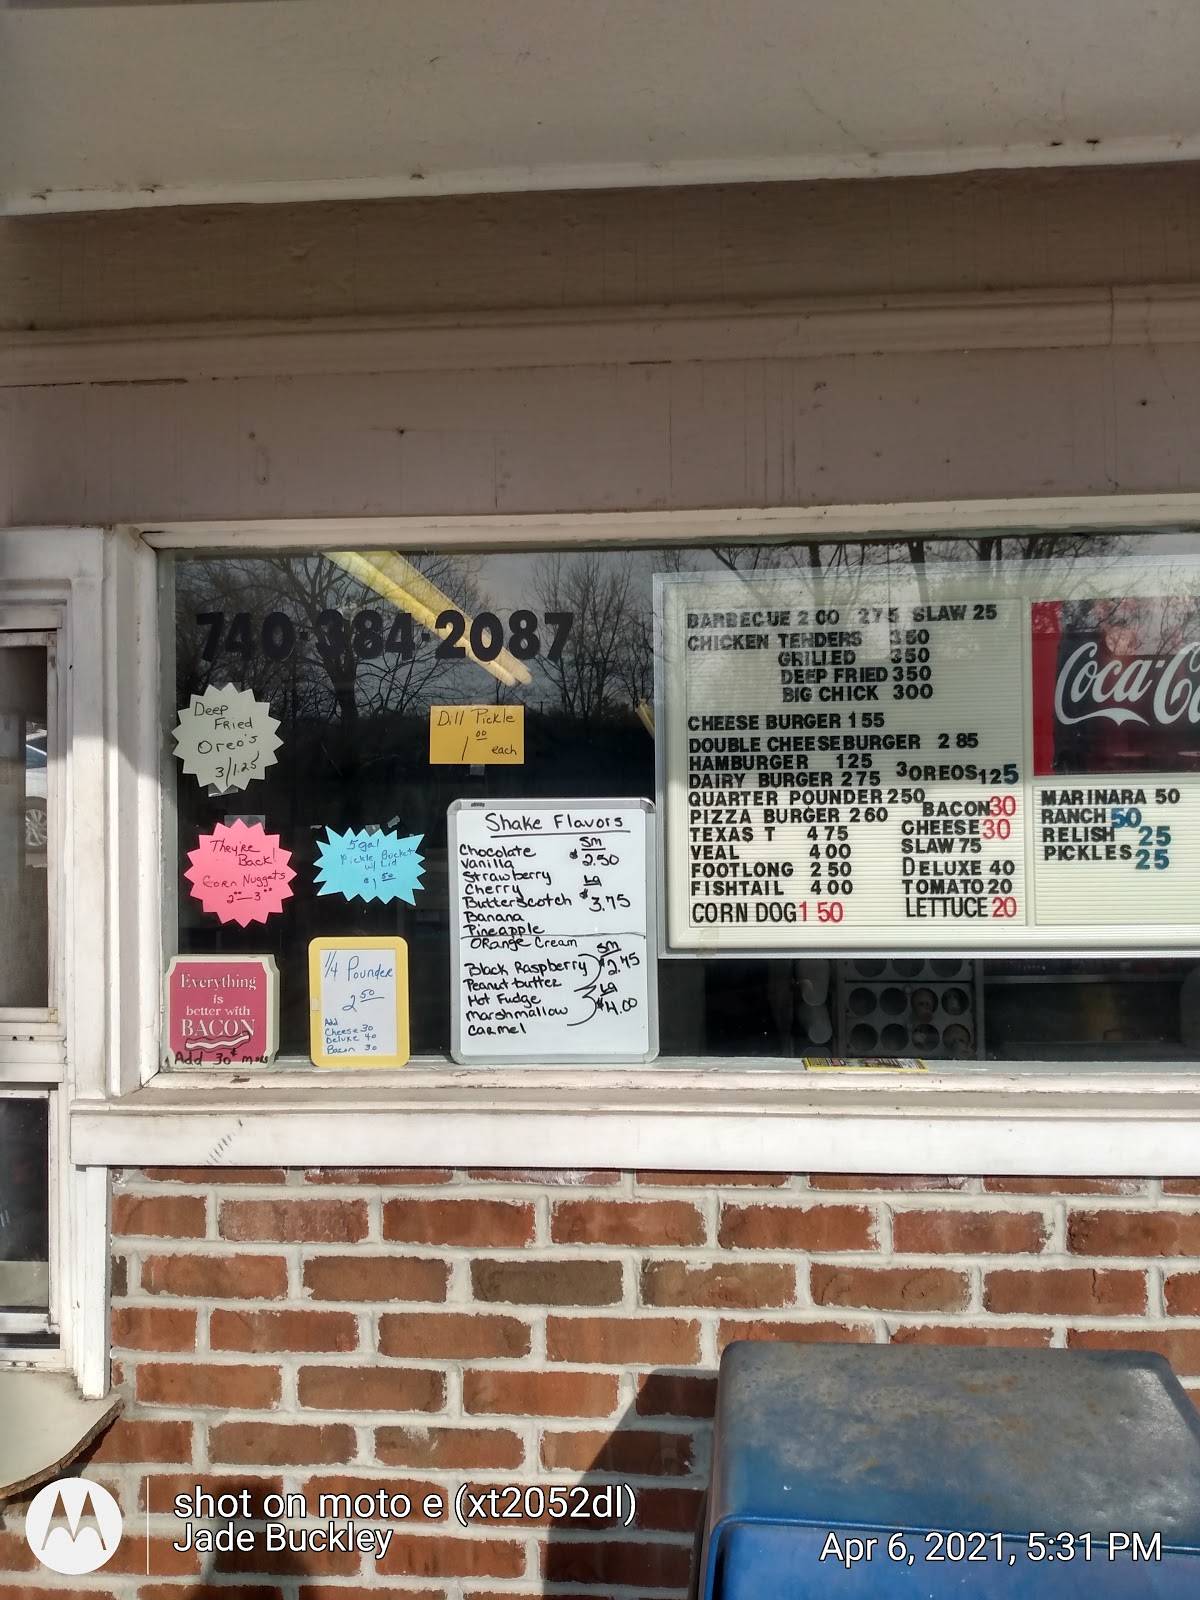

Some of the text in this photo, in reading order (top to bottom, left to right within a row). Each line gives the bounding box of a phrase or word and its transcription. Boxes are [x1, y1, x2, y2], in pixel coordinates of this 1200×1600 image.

[687, 610, 791, 629] BARBECUE
[913, 605, 967, 622] SLAW
[973, 604, 998, 620] 25
[688, 634, 769, 651] CHICKEN
[778, 631, 863, 648] TENDERS
[778, 648, 930, 667] GRILLED 350
[781, 666, 932, 685] DEEP FRIED 350
[782, 684, 934, 703] BIG CHICK 300
[471, 708, 515, 724] Pickle
[688, 714, 759, 731] CHEESE
[766, 713, 841, 730] BURGER
[491, 744, 517, 755] each
[689, 737, 761, 753] DOUBLE
[767, 734, 921, 751] CHEESEBURGER
[690, 753, 873, 771] HAMBURGER 125
[690, 773, 746, 789] DAIRY
[759, 771, 833, 787] BURGER
[688, 788, 926, 807] QUARTER POUNDER 250
[922, 795, 1016, 817] BACON 30
[1041, 789, 1180, 806] MARINARA 50
[485, 812, 623, 832] Shake Flavors
[690, 809, 751, 825] PIZZA
[763, 808, 840, 823] BURGER
[1041, 807, 1142, 828] RANCH 50
[690, 826, 754, 843] TEXAS
[764, 826, 776, 841] T
[901, 819, 1011, 839] CHEESE 30
[1042, 826, 1171, 846] RELISH 25
[459, 843, 536, 858] Chocolate
[690, 845, 740, 860] VEAL
[901, 838, 982, 854] SLAW 75
[1044, 844, 1170, 870] PICKLES 25
[691, 862, 794, 878] FOOTLONG
[903, 857, 1015, 876] DELUXE 40
[243, 869, 286, 887] Nuggets
[463, 871, 552, 885] Strawberry
[465, 884, 523, 899] Cherry
[691, 880, 784, 897] FISHTAIL
[902, 879, 1012, 895] TOMATO 20
[463, 894, 572, 909] Butterscotch
[905, 896, 1017, 918] LETTUCE 20
[464, 911, 524, 923] Banana
[692, 902, 748, 924] CORN
[755, 902, 797, 923] DOG
[463, 923, 545, 938] Pineapple
[535, 936, 578, 948] Cream
[464, 959, 588, 976] Black Raspberry
[181, 973, 257, 991] Everything
[463, 978, 509, 992] Peanut
[213, 994, 224, 1004] is
[468, 994, 541, 1008] Hot Fudge
[186, 1005, 251, 1016] better with
[182, 1019, 256, 1037] BACON
[174, 1051, 203, 1065] Add
